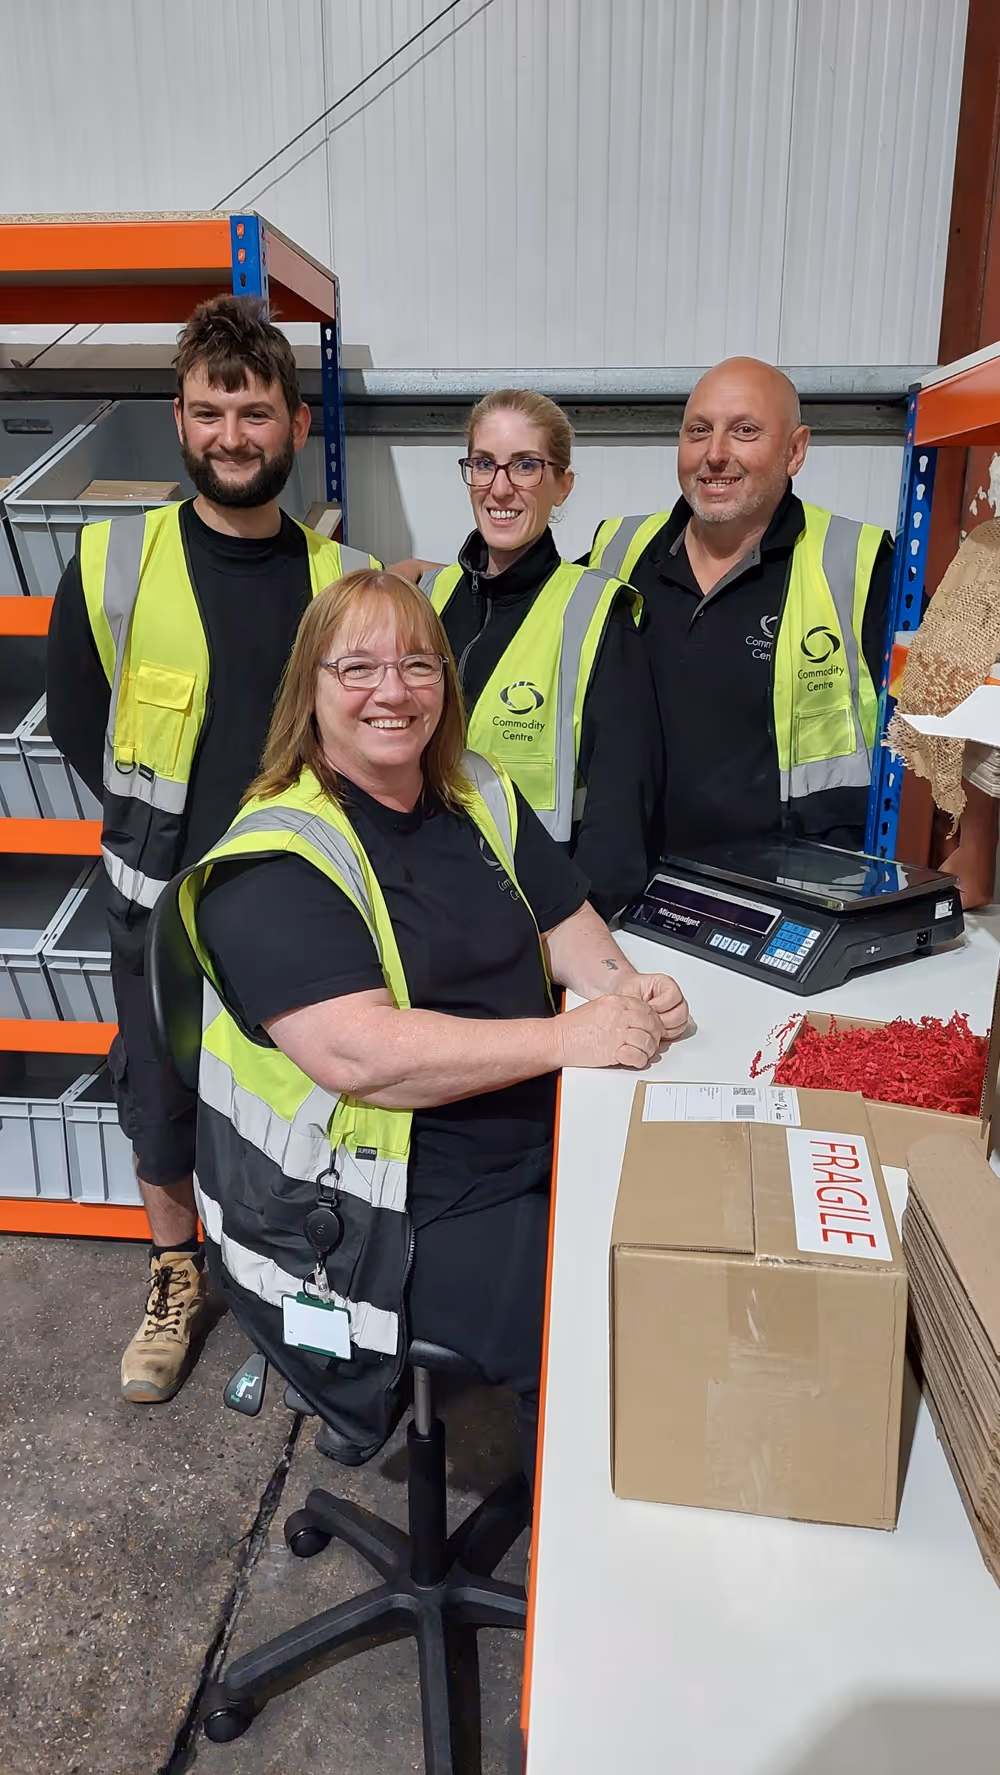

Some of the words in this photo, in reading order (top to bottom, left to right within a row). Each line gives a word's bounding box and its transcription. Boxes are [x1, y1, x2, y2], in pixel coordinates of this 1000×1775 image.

[797, 664, 845, 680] Commodity
[807, 681, 833, 692] Centre
[492, 716, 545, 732] Commodity
[502, 730, 533, 741] Centre
[658, 907, 700, 927] Microgadget
[809, 1140, 877, 1248] FRAGILE
